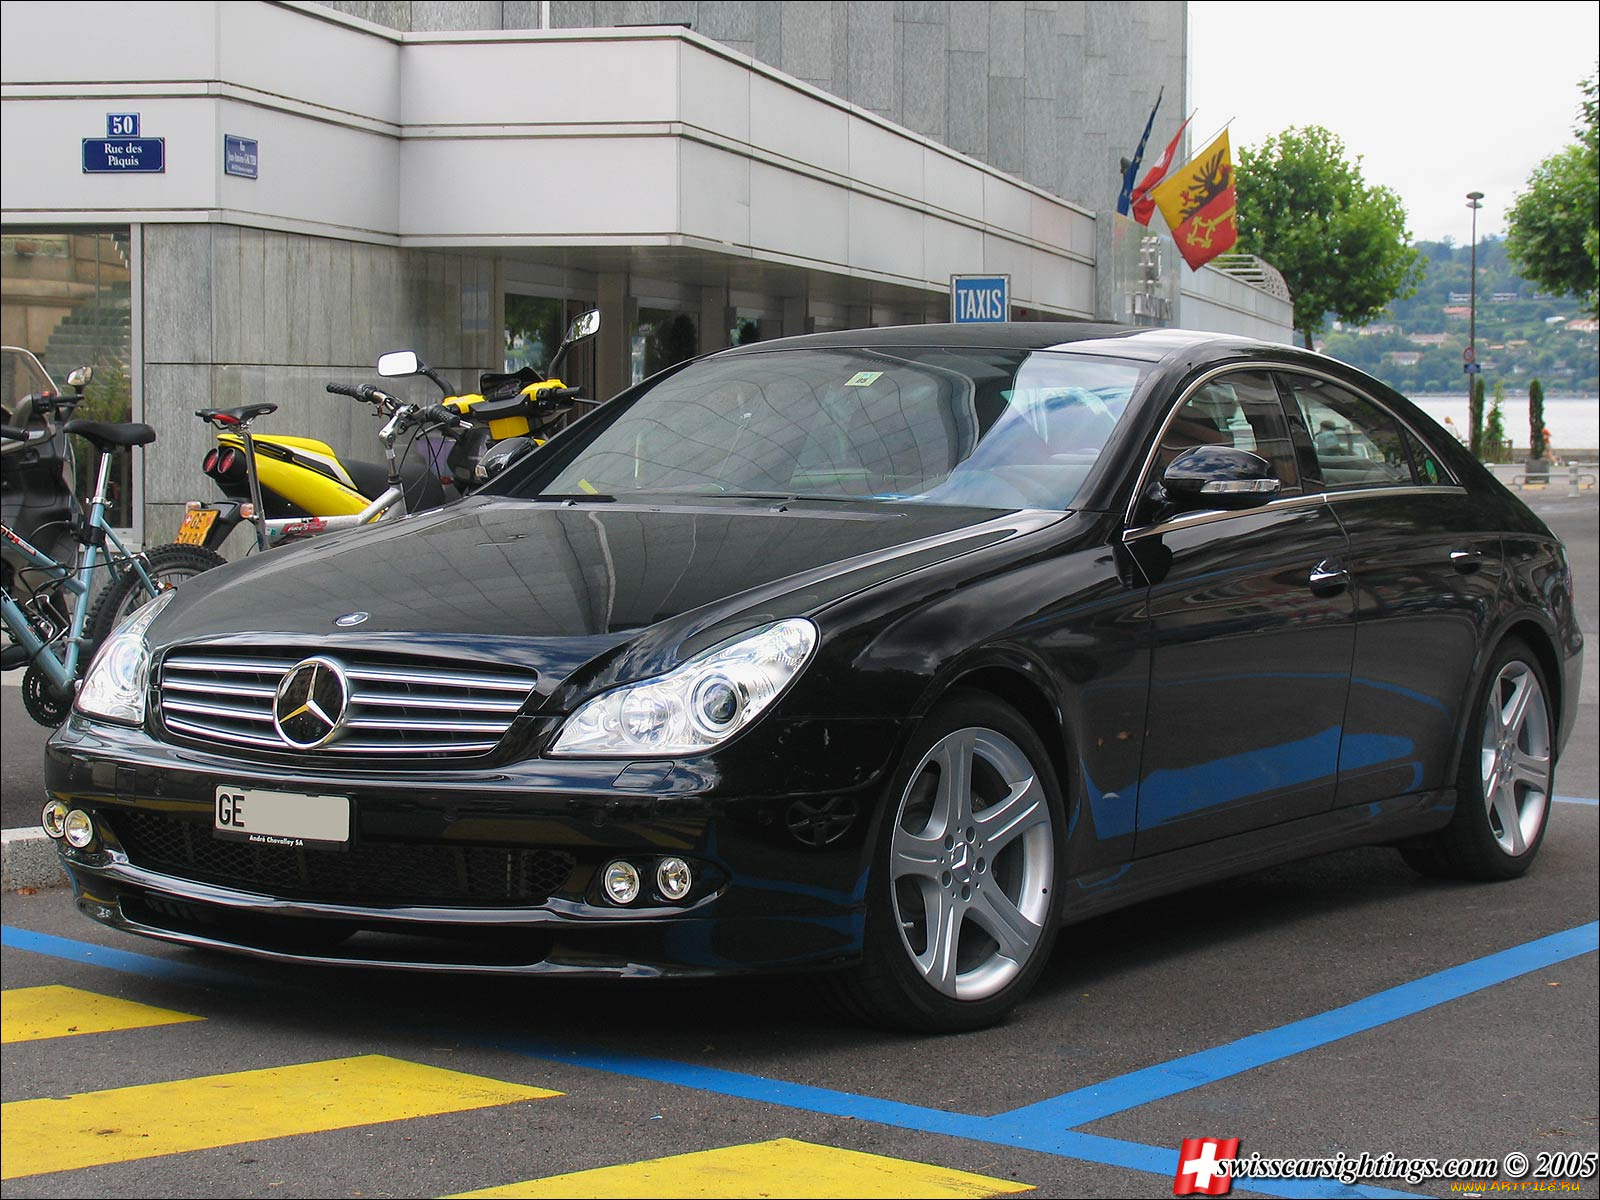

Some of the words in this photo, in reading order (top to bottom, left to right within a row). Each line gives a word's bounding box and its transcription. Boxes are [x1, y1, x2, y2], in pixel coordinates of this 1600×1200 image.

[113, 116, 133, 134] 50
[104, 143, 123, 153] Rue
[125, 142, 142, 153] des
[108, 155, 139, 168] Pâquis
[957, 289, 1002, 319] TAXIS
[218, 793, 245, 827] GE
